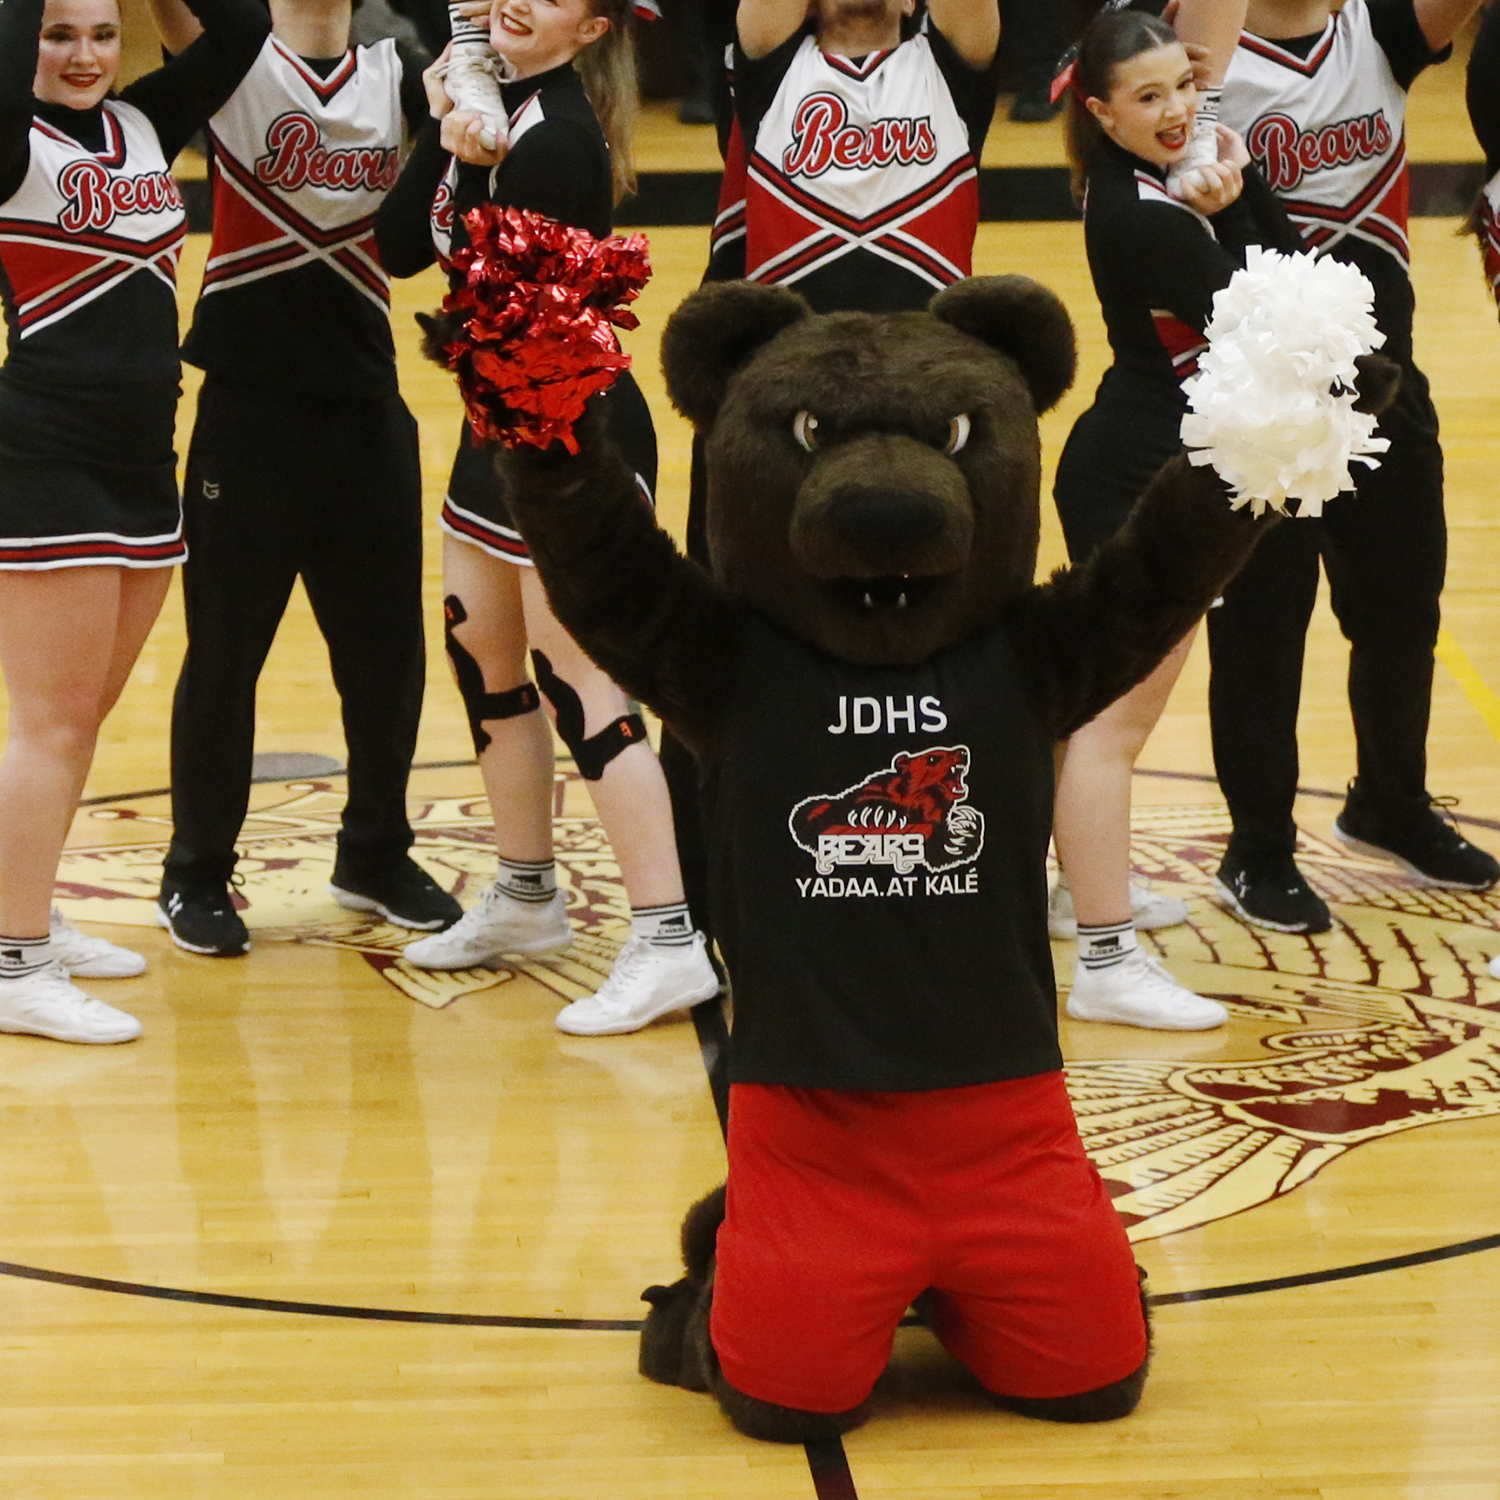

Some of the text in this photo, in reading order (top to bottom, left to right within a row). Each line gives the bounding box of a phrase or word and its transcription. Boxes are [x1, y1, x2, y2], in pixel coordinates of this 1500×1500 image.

[782, 91, 936, 179] Bears
[1246, 109, 1392, 192] Bears
[827, 695, 949, 735] JDHS
[816, 834, 926, 875] BEARS
[795, 867, 979, 898] YADAA.AT KALÉ
